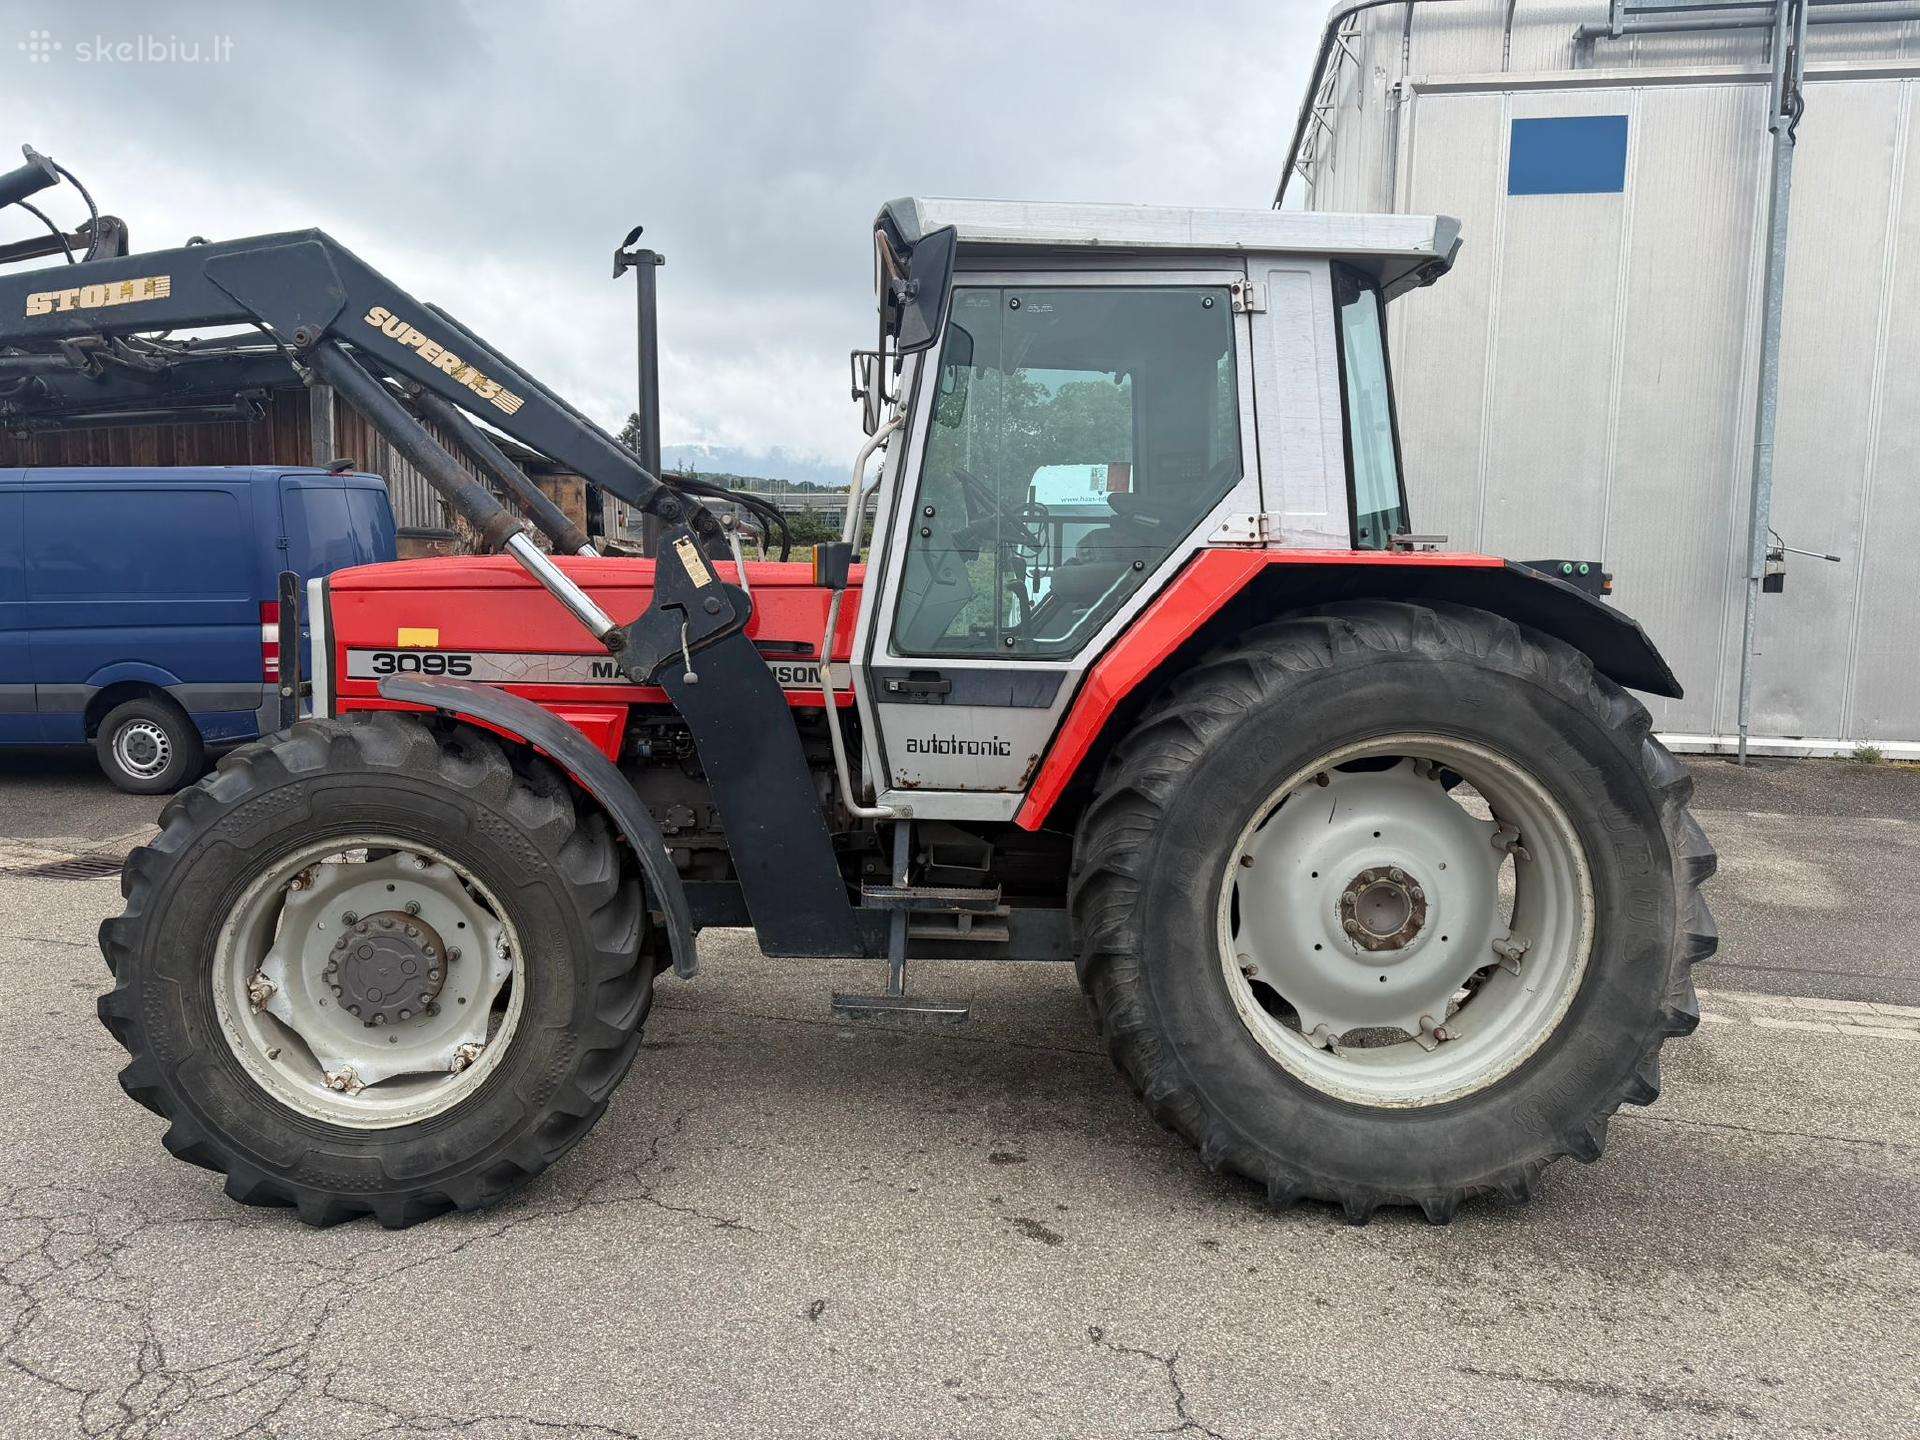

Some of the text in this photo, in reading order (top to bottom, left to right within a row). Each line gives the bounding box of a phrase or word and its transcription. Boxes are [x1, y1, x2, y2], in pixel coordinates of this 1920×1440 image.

[26, 277, 156, 316] STOLL
[363, 306, 463, 376] SUPER
[372, 653, 473, 676] 3095
[906, 733, 1011, 756] autotronic
